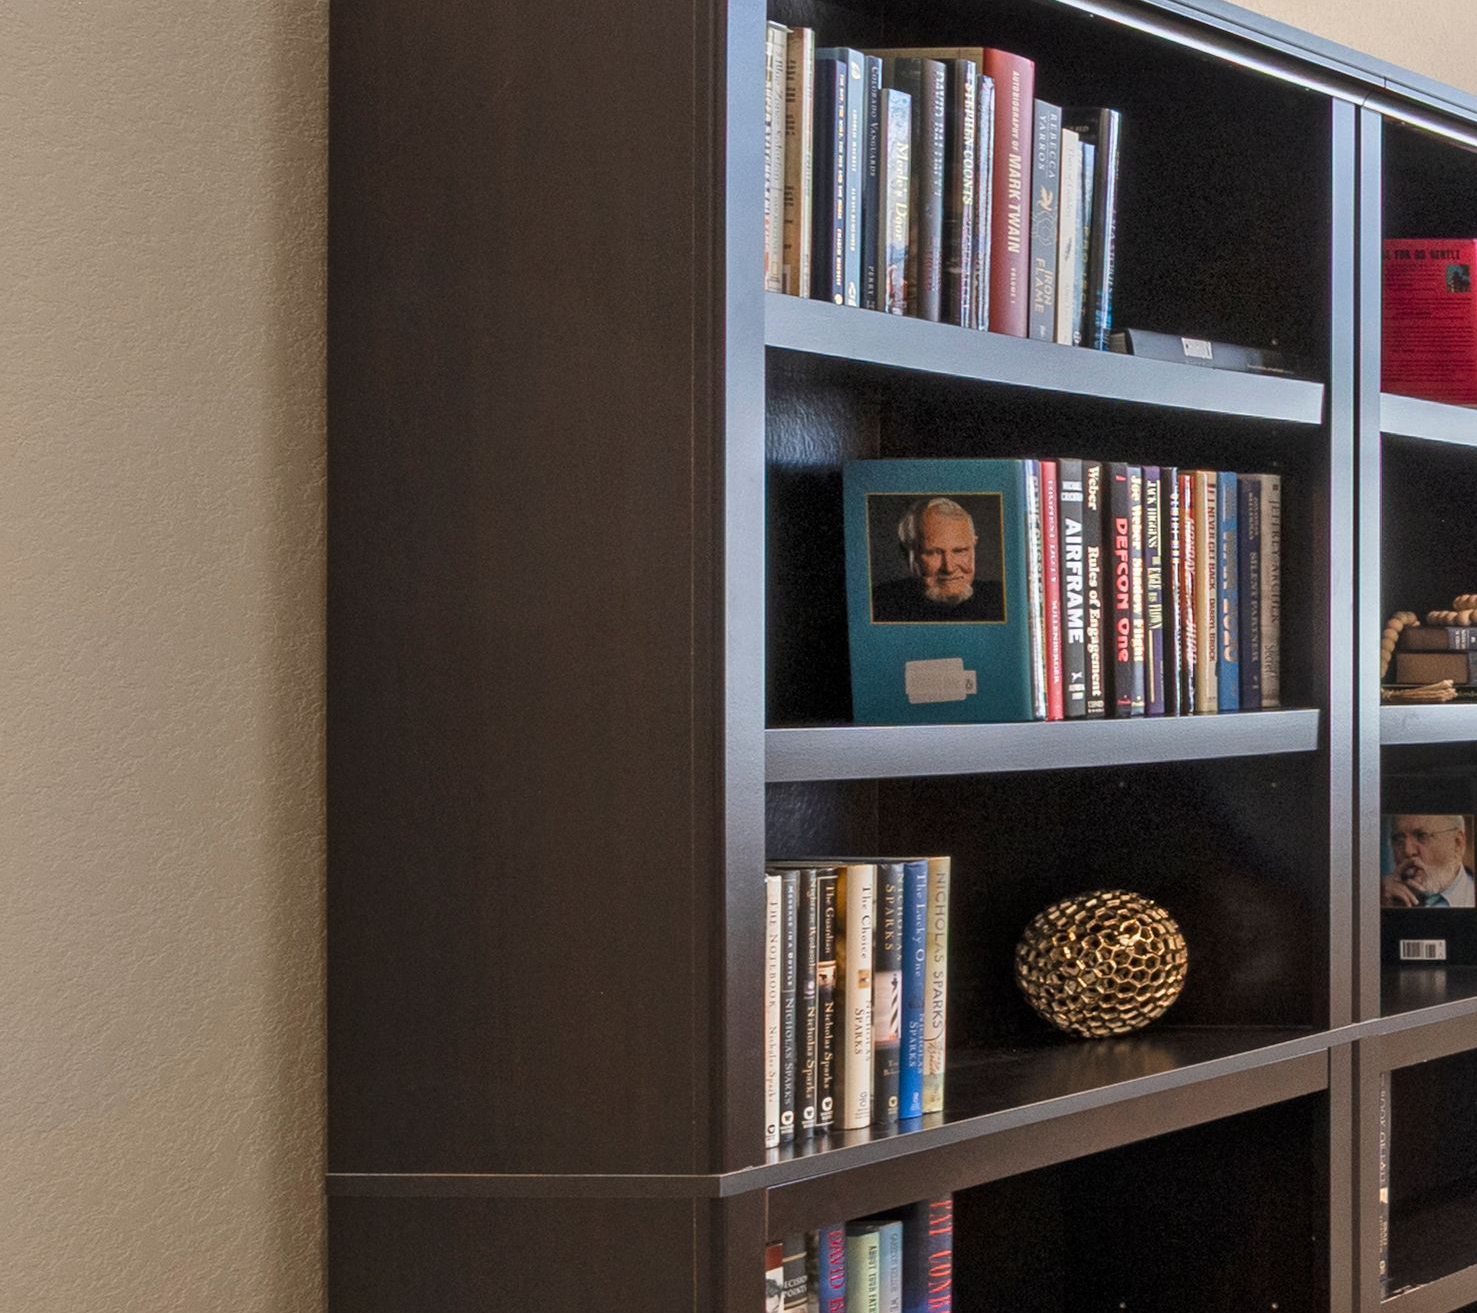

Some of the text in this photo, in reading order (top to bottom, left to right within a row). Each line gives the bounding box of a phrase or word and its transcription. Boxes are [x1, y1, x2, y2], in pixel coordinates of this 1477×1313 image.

[869, 66, 880, 177] COLORADO VANGUARDS
[963, 82, 974, 145] STEPHEN
[1011, 71, 1021, 138] AUTOBIOGRAPHY
[1011, 140, 1019, 152] OF
[1037, 114, 1047, 170] YARROS
[1047, 113, 1058, 178] REBECCA
[894, 142, 909, 241] Merle's Door
[962, 149, 974, 206] COONTS
[1008, 153, 1022, 199] MARK
[1007, 204, 1022, 254] TWAIN
[1033, 258, 1045, 313] FLAME
[1043, 270, 1054, 306] IRON
[1087, 466, 1100, 511] Weber
[1147, 480, 1158, 505] JACK
[1206, 482, 1217, 495] IF
[1147, 508, 1158, 548] HIGGINS
[1207, 506, 1216, 540] NEVER
[1208, 541, 1216, 560] GET
[1065, 518, 1084, 644] AIRFRAME
[1115, 518, 1130, 663] DEFCON One
[1130, 475, 1144, 663] Joe Weber Shadow Flight
[1147, 567, 1163, 589] EAGLE
[1208, 562, 1216, 590] BACK
[1268, 500, 1281, 623] JEFFREY ARCHER
[1086, 546, 1102, 697] Rules of Engagement
[1147, 603, 1163, 630] FLOWN
[1208, 598, 1217, 662] DARRYL BROCK
[1249, 551, 1260, 663] SILENT PARTNER
[1050, 599, 1060, 684] SULLENBERGER
[786, 885, 794, 928] MESSAGE
[824, 885, 835, 954] The Guardian
[860, 885, 871, 960] The Choice
[884, 884, 896, 952] SPARKS
[912, 871, 928, 978] The Lucky One
[769, 900, 779, 1008] THE NOTEBOOK
[786, 951, 794, 986] BOTTLE
[931, 872, 947, 1030] NICHOLAS SPARKS
[783, 997, 795, 1106] NICHOLAS SPARKS
[802, 1005, 817, 1099] Nicholas Sparks
[820, 1001, 835, 1089] Nicholas Sparks
[854, 1007, 866, 1055] SPARKS
[908, 1020, 919, 1067] SPARKS
[767, 1026, 778, 1103] Nicholas Sparks
[926, 1199, 953, 1237] PAT
[828, 1229, 847, 1289] DAVID
[867, 1245, 878, 1271] ABOUT
[889, 1297, 899, 1313] WE
